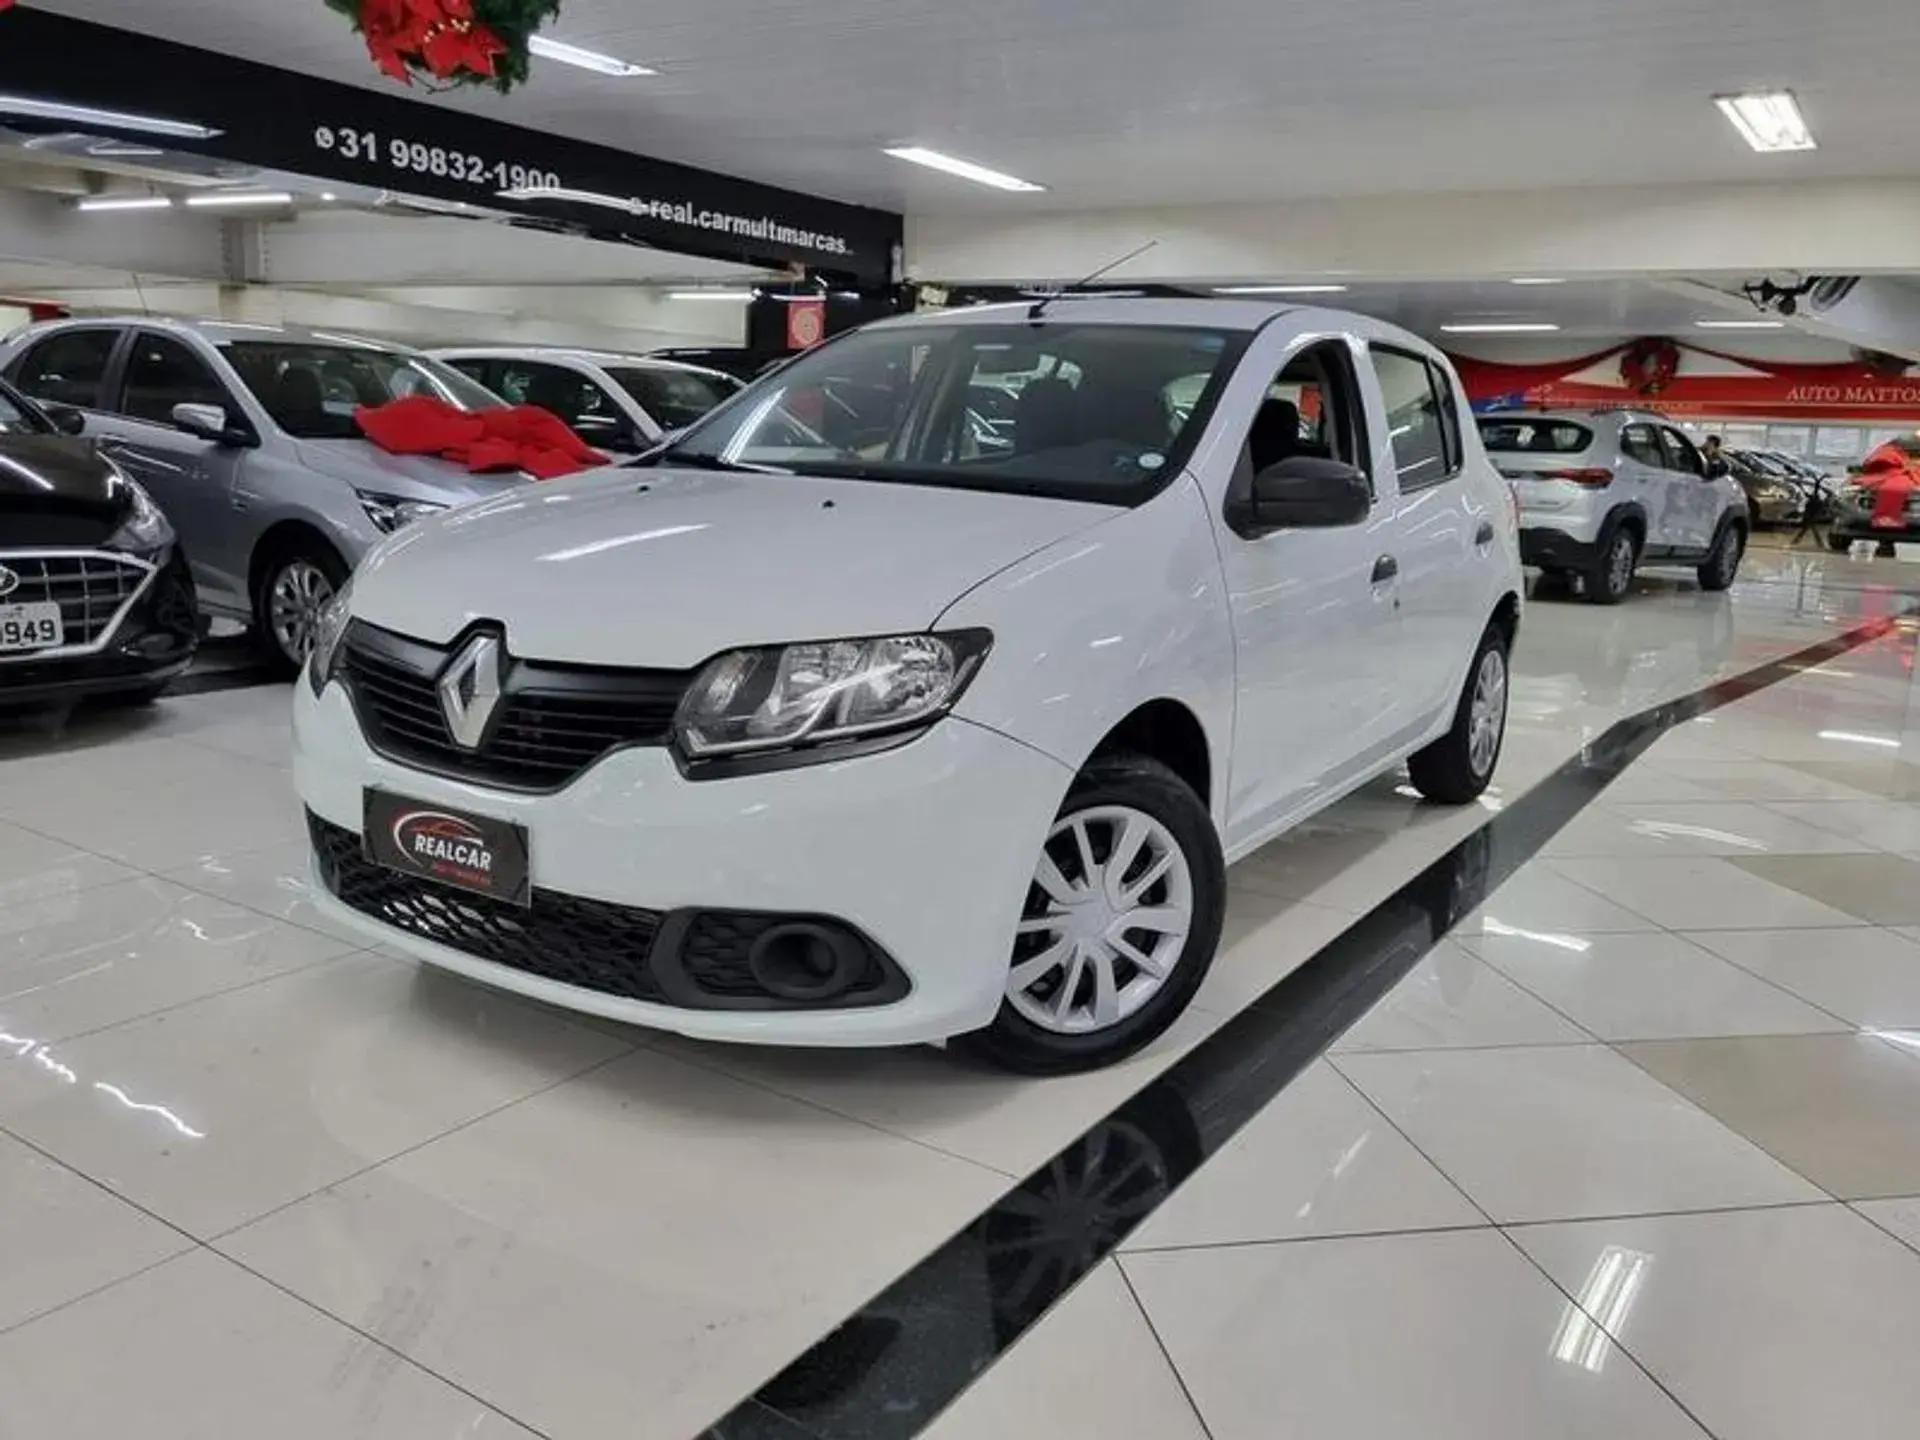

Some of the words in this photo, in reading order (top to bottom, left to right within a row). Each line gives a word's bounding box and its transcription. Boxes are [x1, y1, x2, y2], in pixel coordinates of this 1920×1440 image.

[338, 127, 377, 162] 31
[390, 139, 560, 191] 99832-1900
[1786, 384, 1840, 404] AUTO
[0, 619, 56, 645] 949
[414, 833, 492, 871] REALCAR
